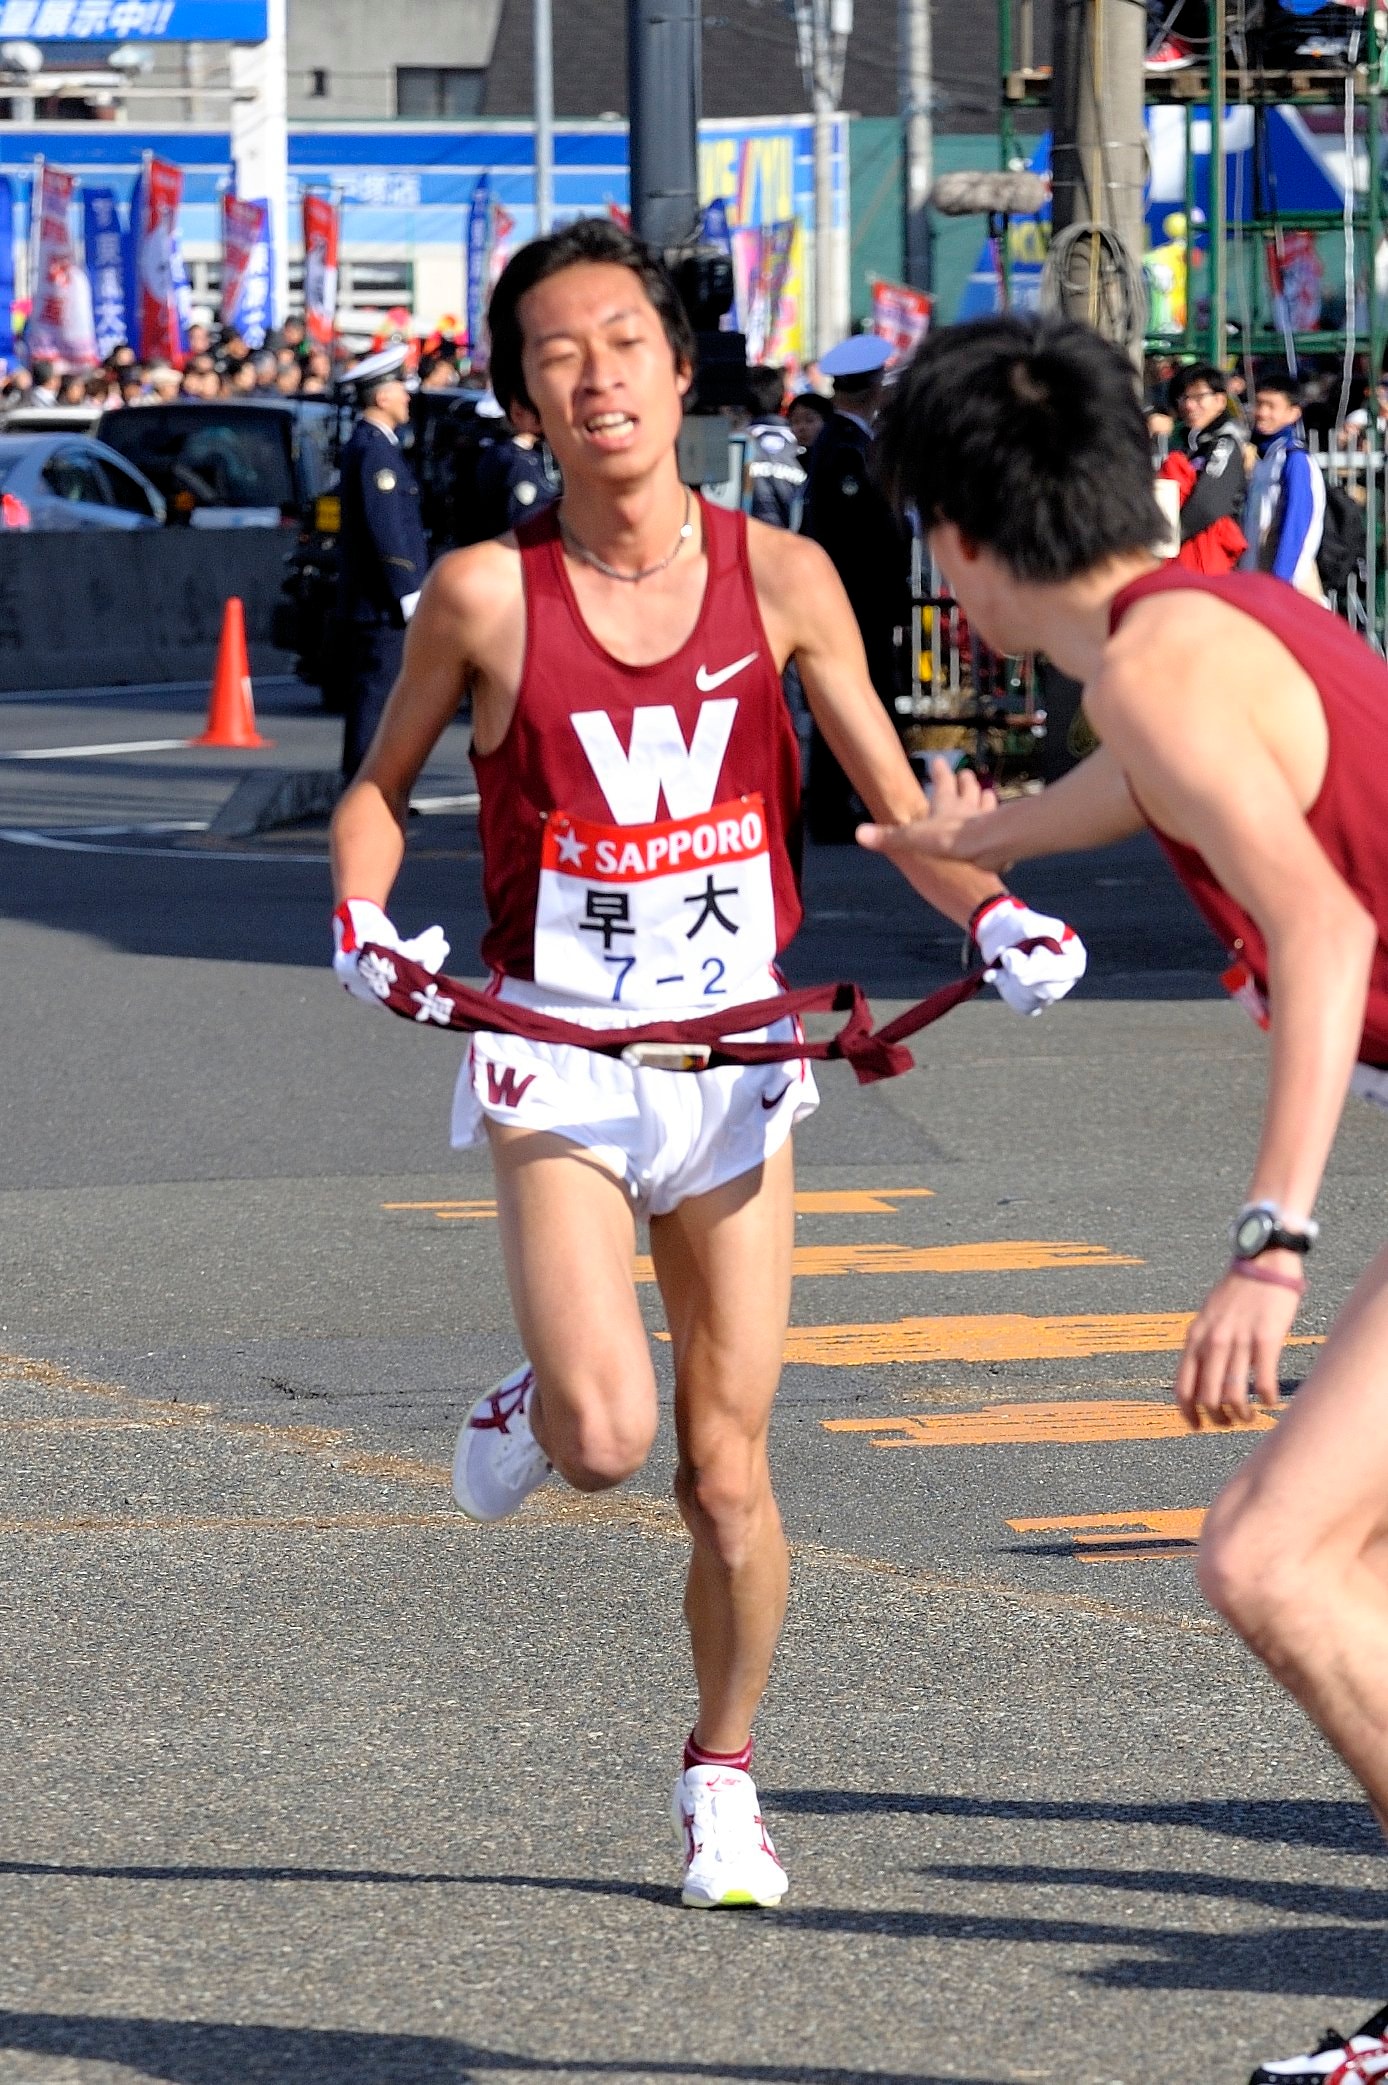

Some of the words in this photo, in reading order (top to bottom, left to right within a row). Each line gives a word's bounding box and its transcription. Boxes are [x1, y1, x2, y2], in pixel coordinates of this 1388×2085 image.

[569, 697, 739, 826] W
[594, 812, 763, 875] SAPPORO
[486, 1062, 536, 1108] W
